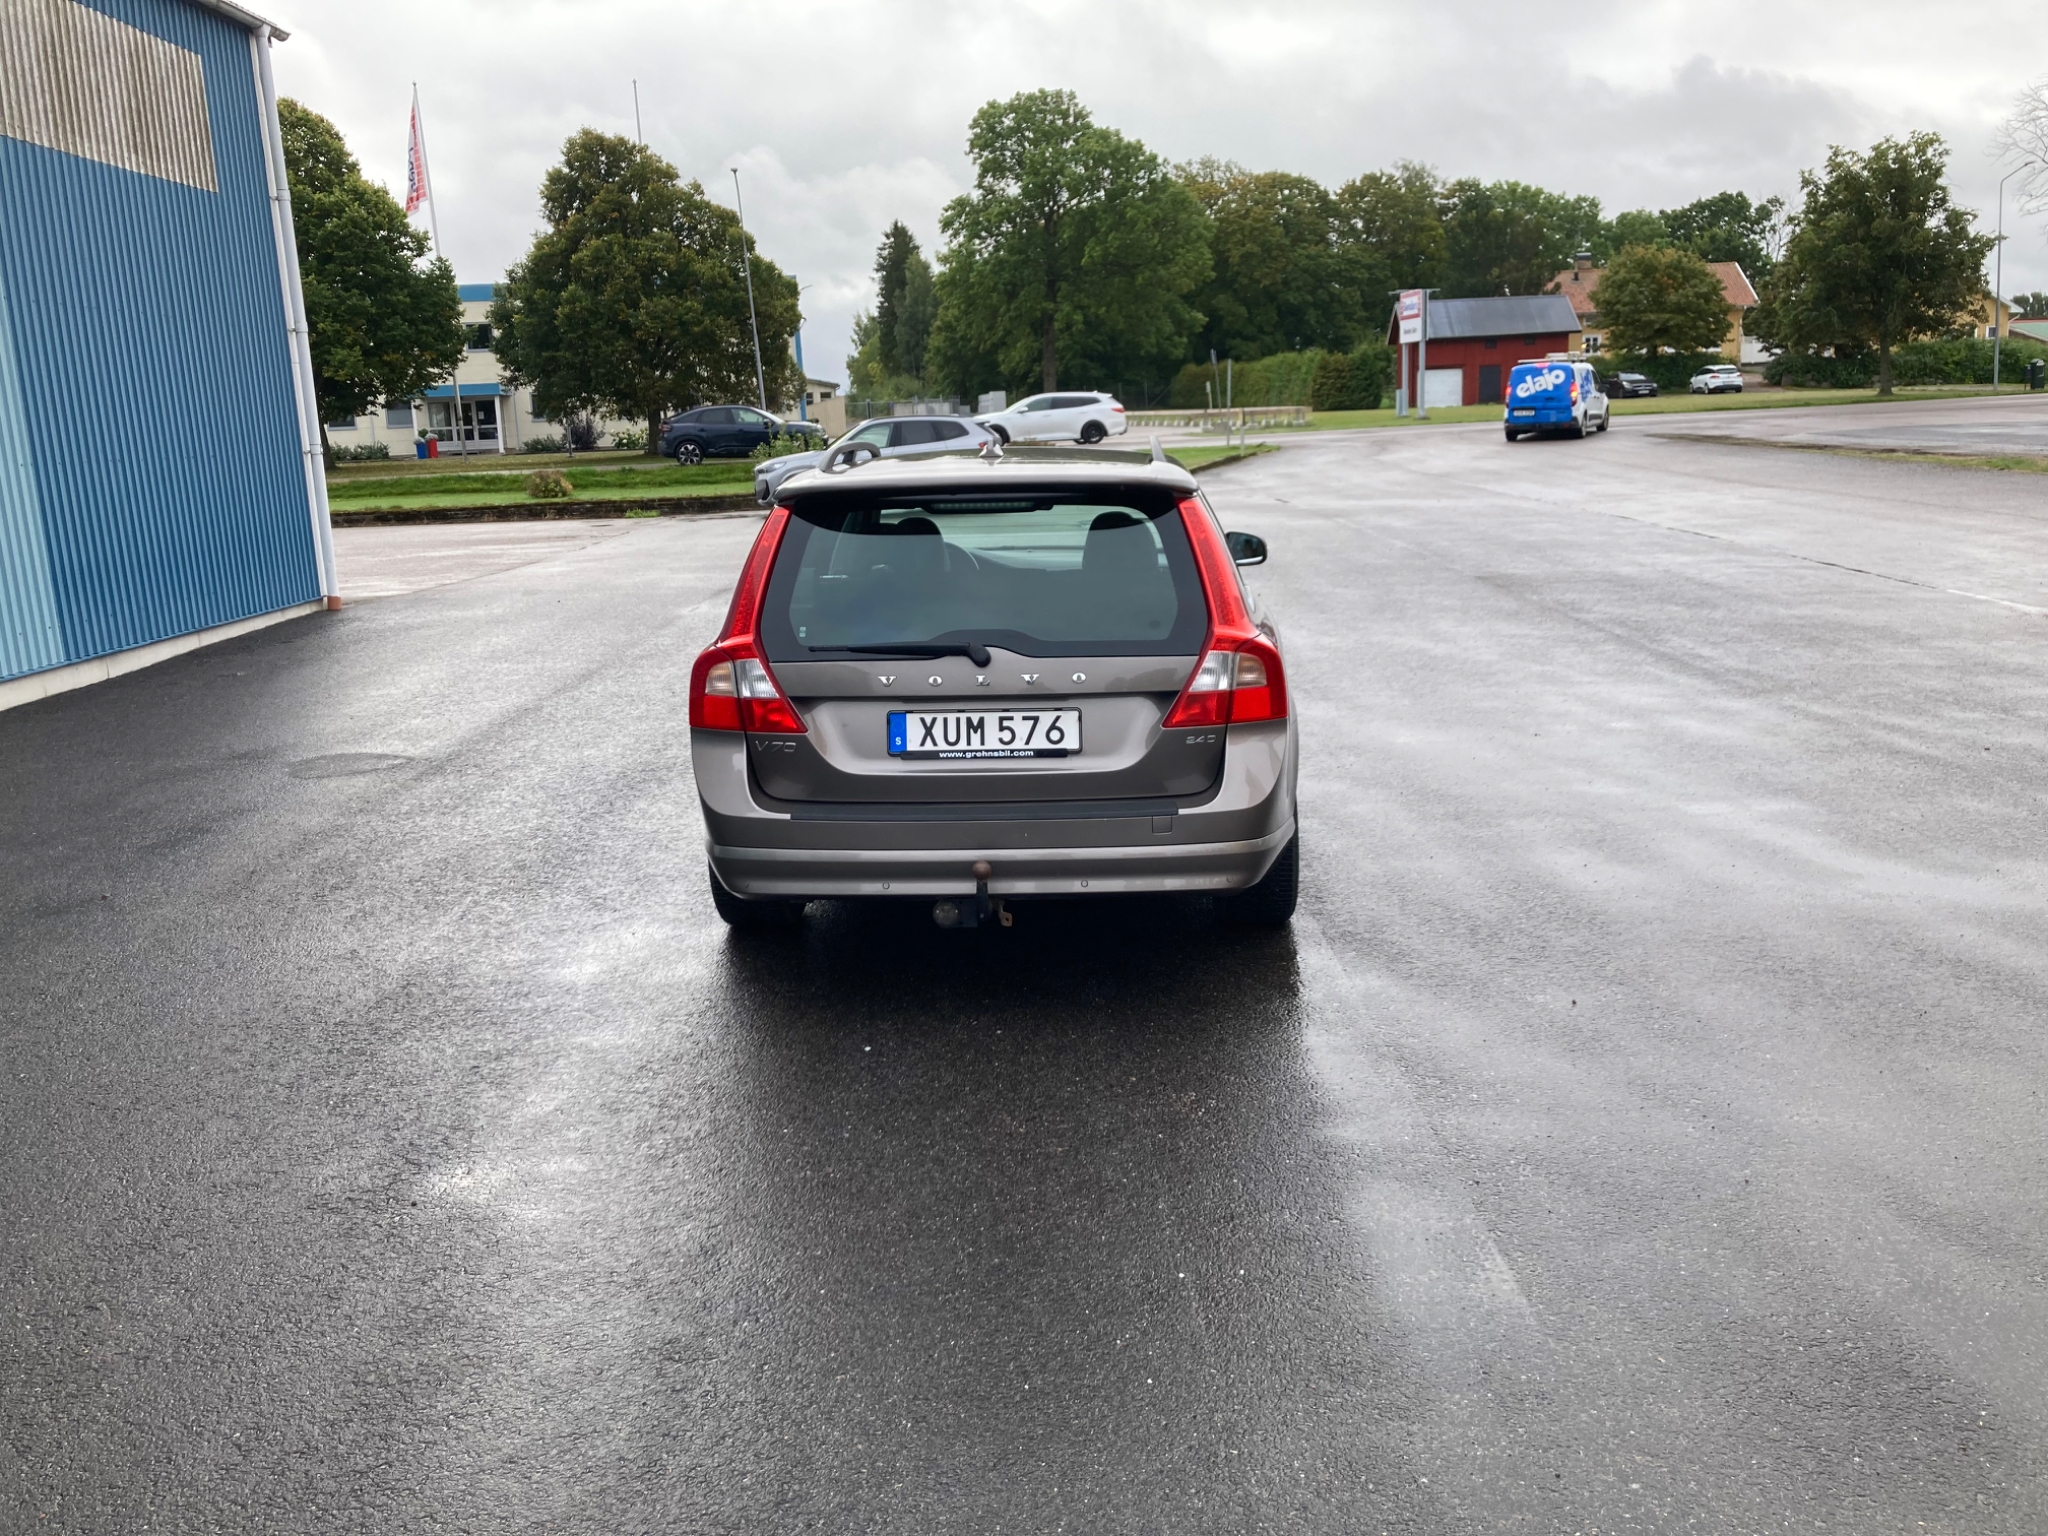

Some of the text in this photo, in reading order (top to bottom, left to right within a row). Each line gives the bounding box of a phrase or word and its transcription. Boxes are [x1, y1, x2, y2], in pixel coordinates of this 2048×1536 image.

[1516, 368, 1566, 398] elajo
[878, 672, 1087, 687] VOLVO
[919, 714, 1065, 747] XUM 576
[755, 740, 797, 752] V70
[895, 737, 902, 746] S
[939, 749, 1034, 759] www.grehnsbil.com
